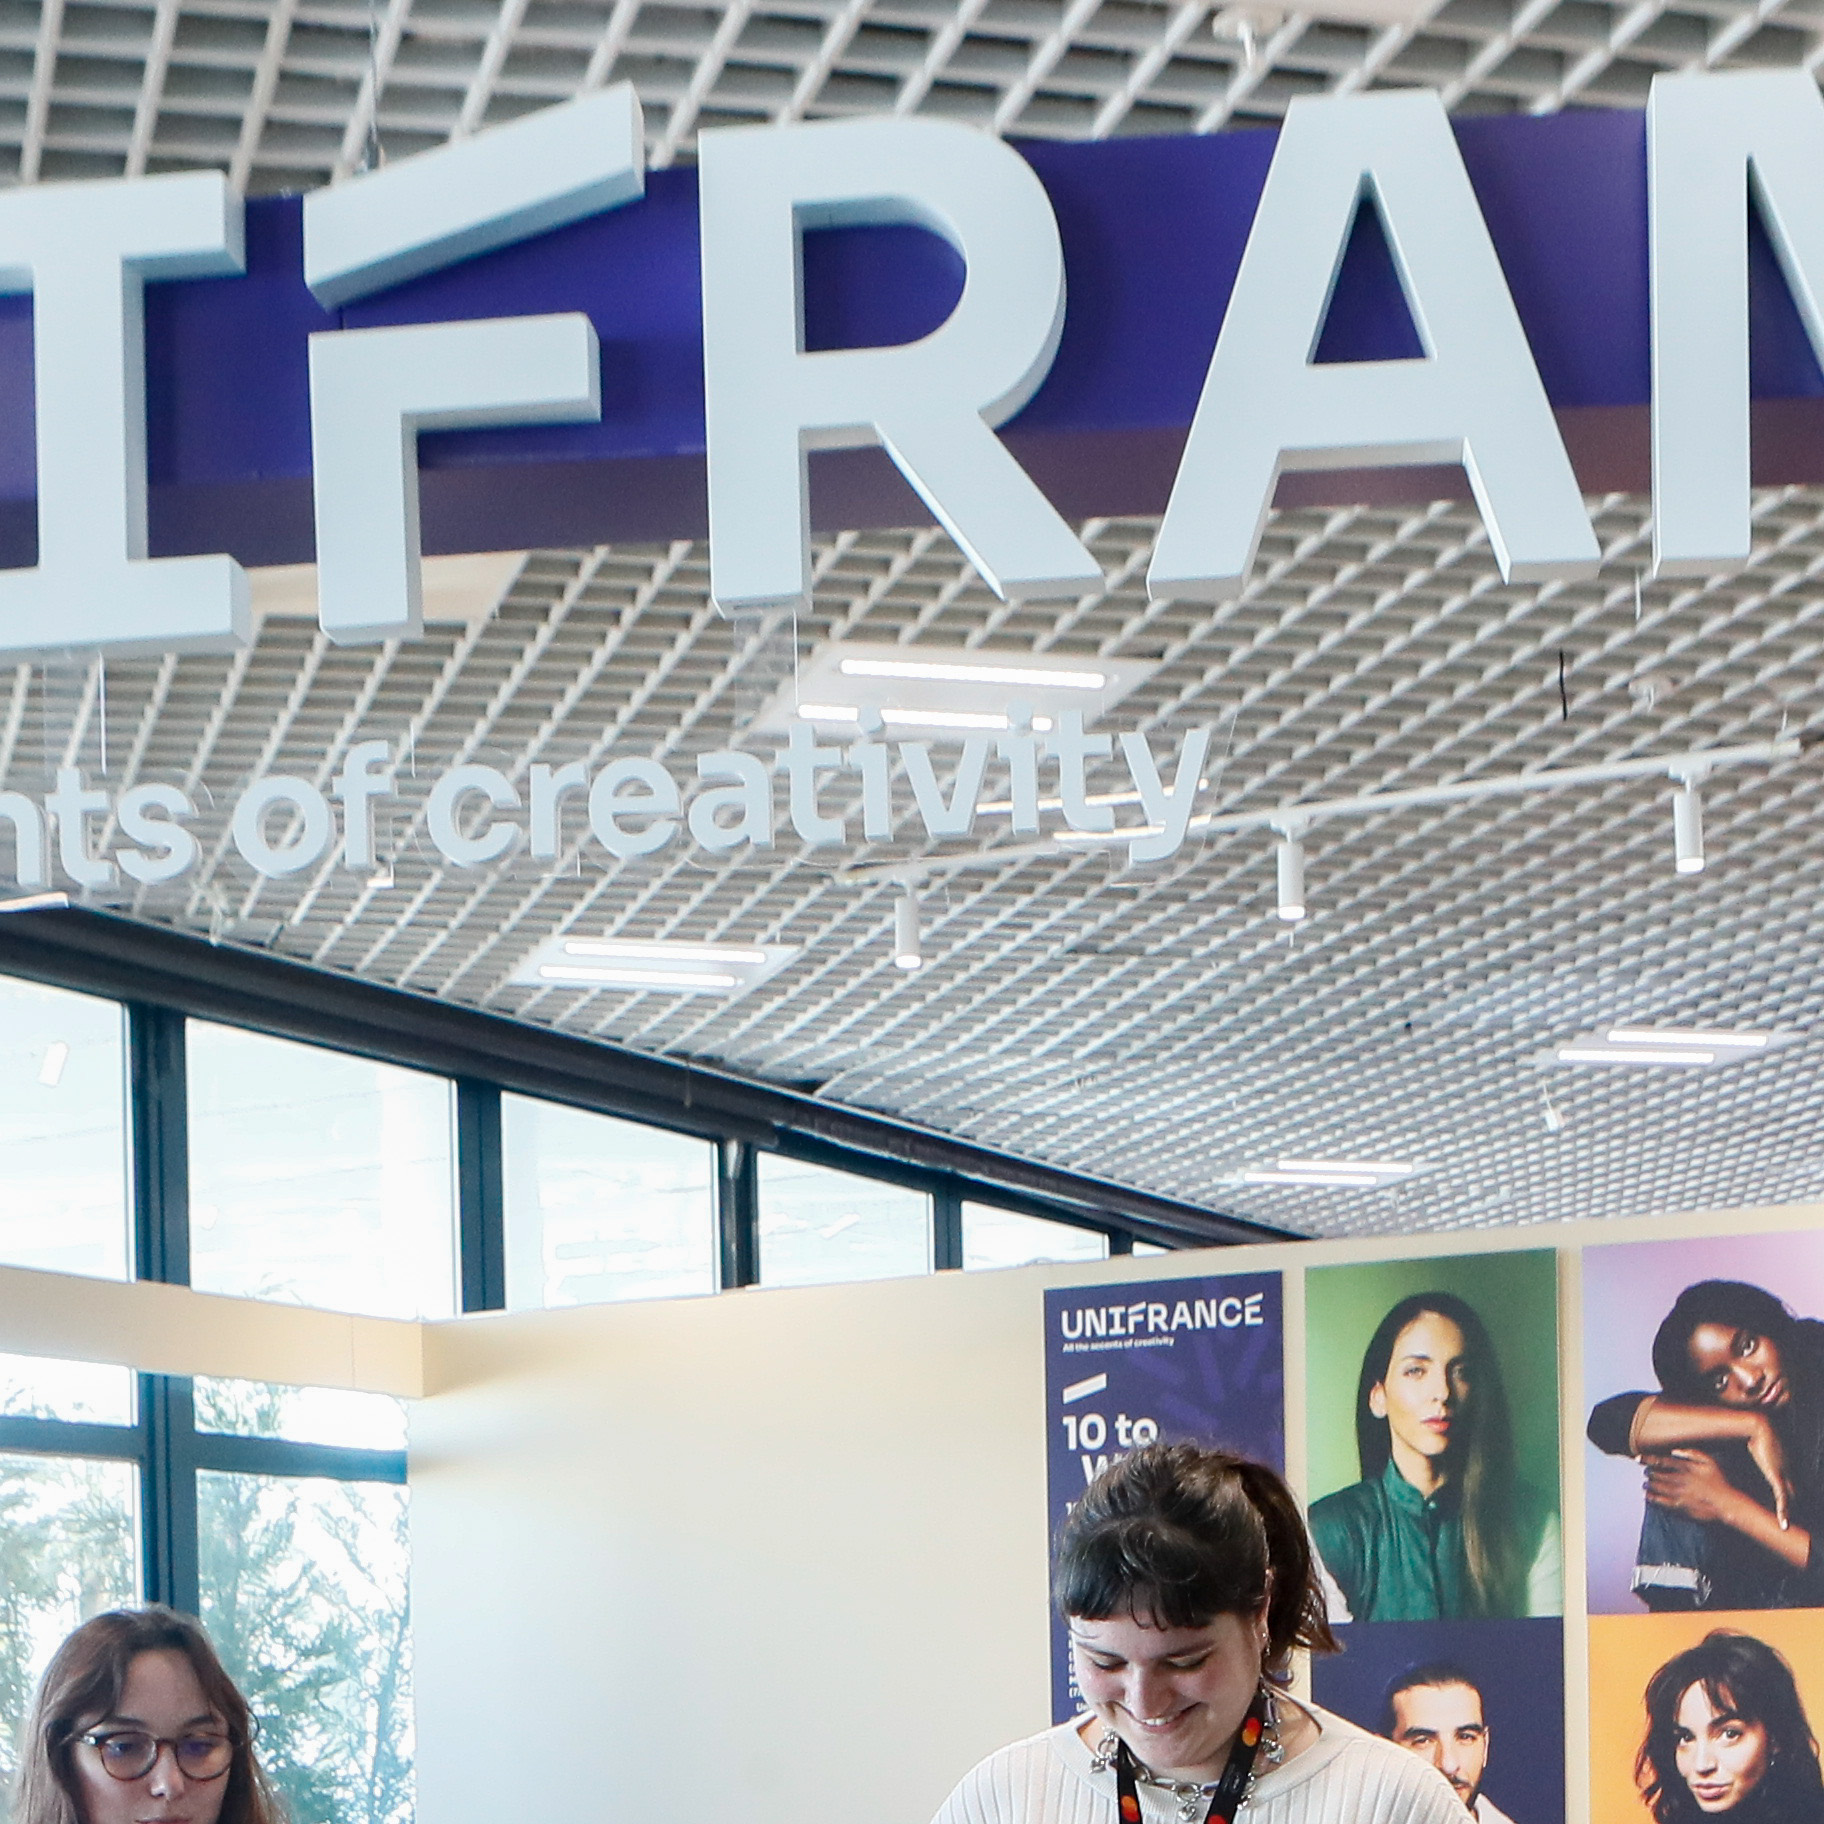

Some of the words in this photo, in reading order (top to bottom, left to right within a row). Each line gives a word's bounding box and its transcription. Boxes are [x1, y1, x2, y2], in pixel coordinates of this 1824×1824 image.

[232, 739, 398, 879] of
[426, 701, 1214, 869] creativity
[1062, 1413, 1107, 1451] 10
[1114, 1413, 1158, 1449] to
